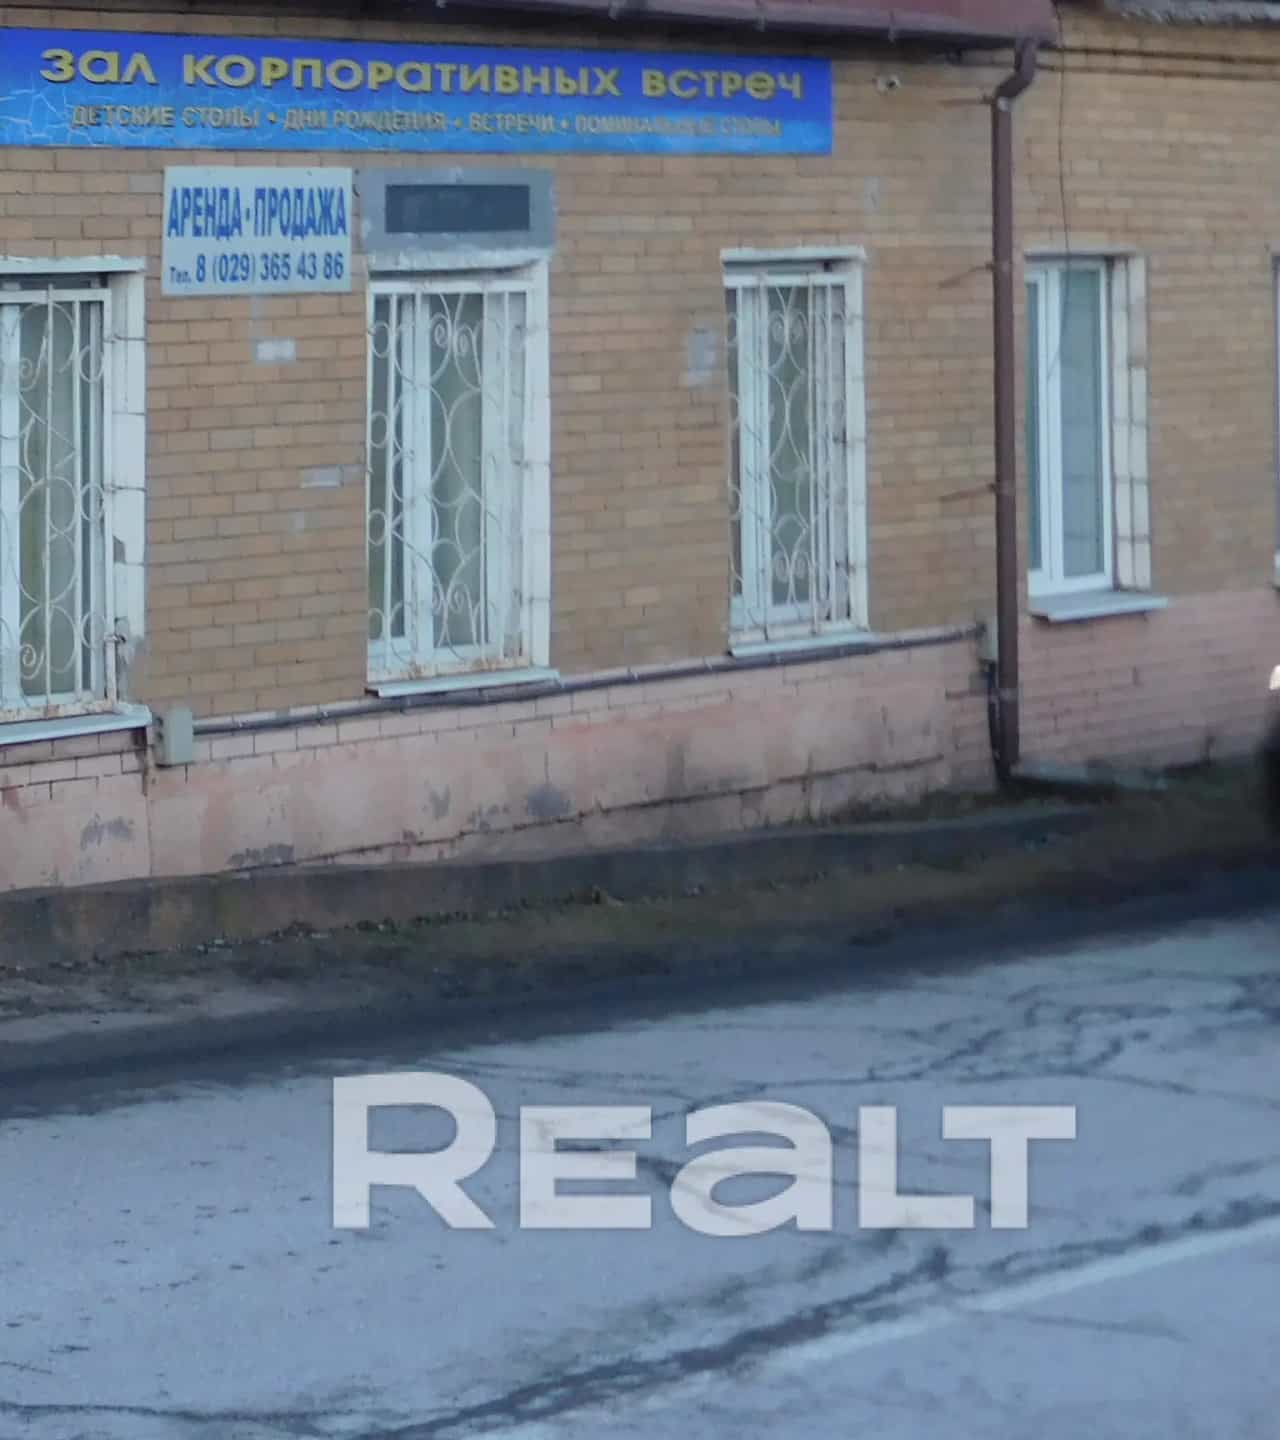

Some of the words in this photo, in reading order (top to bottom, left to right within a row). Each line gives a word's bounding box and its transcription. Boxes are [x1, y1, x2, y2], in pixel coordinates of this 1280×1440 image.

[182, 54, 623, 97] КОРПОРАТИВНЫХ
[71, 105, 176, 129] ДЕТСКИЕ
[182, 106, 258, 130] СТОЛЫ
[283, 108, 330, 133] ДНИ
[334, 109, 447, 134] РОЖДЕНИЯ
[468, 112, 556, 136] ВСТРЕЧИ
[195, 253, 206, 283] 8
[212, 252, 256, 284] (029)
[260, 252, 290, 281] 365
[296, 252, 317, 280] 43
[323, 251, 344, 280] 86
